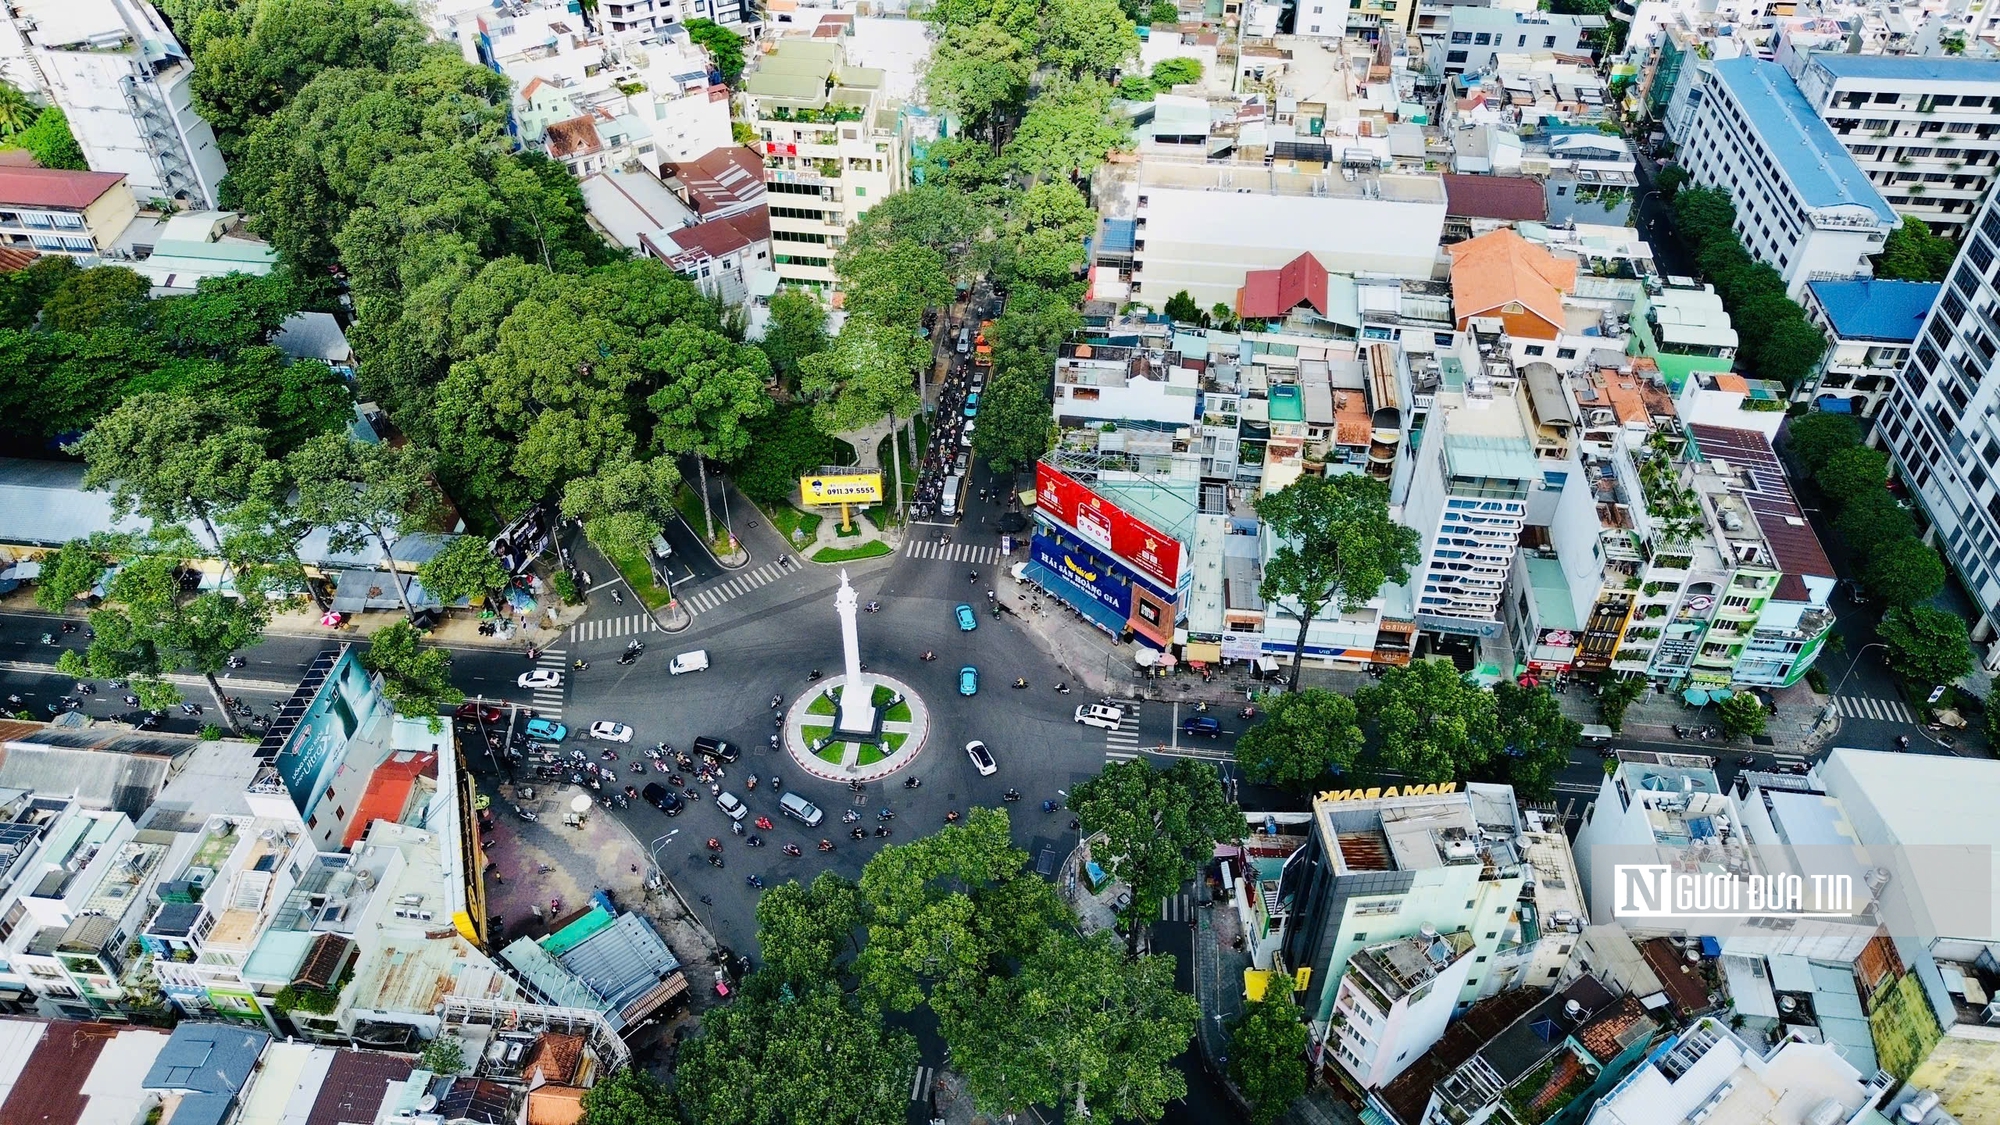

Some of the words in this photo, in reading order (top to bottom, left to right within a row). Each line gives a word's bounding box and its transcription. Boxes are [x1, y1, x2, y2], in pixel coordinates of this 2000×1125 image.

[764, 170, 796, 184] HTH
[796, 172, 820, 180] OFFICE
[826, 487, 875, 496] 0911.39.5555
[1074, 574, 1103, 597] HOÀNG
[1103, 593, 1120, 608] GIA
[1423, 622, 1479, 634] Vietcombank
